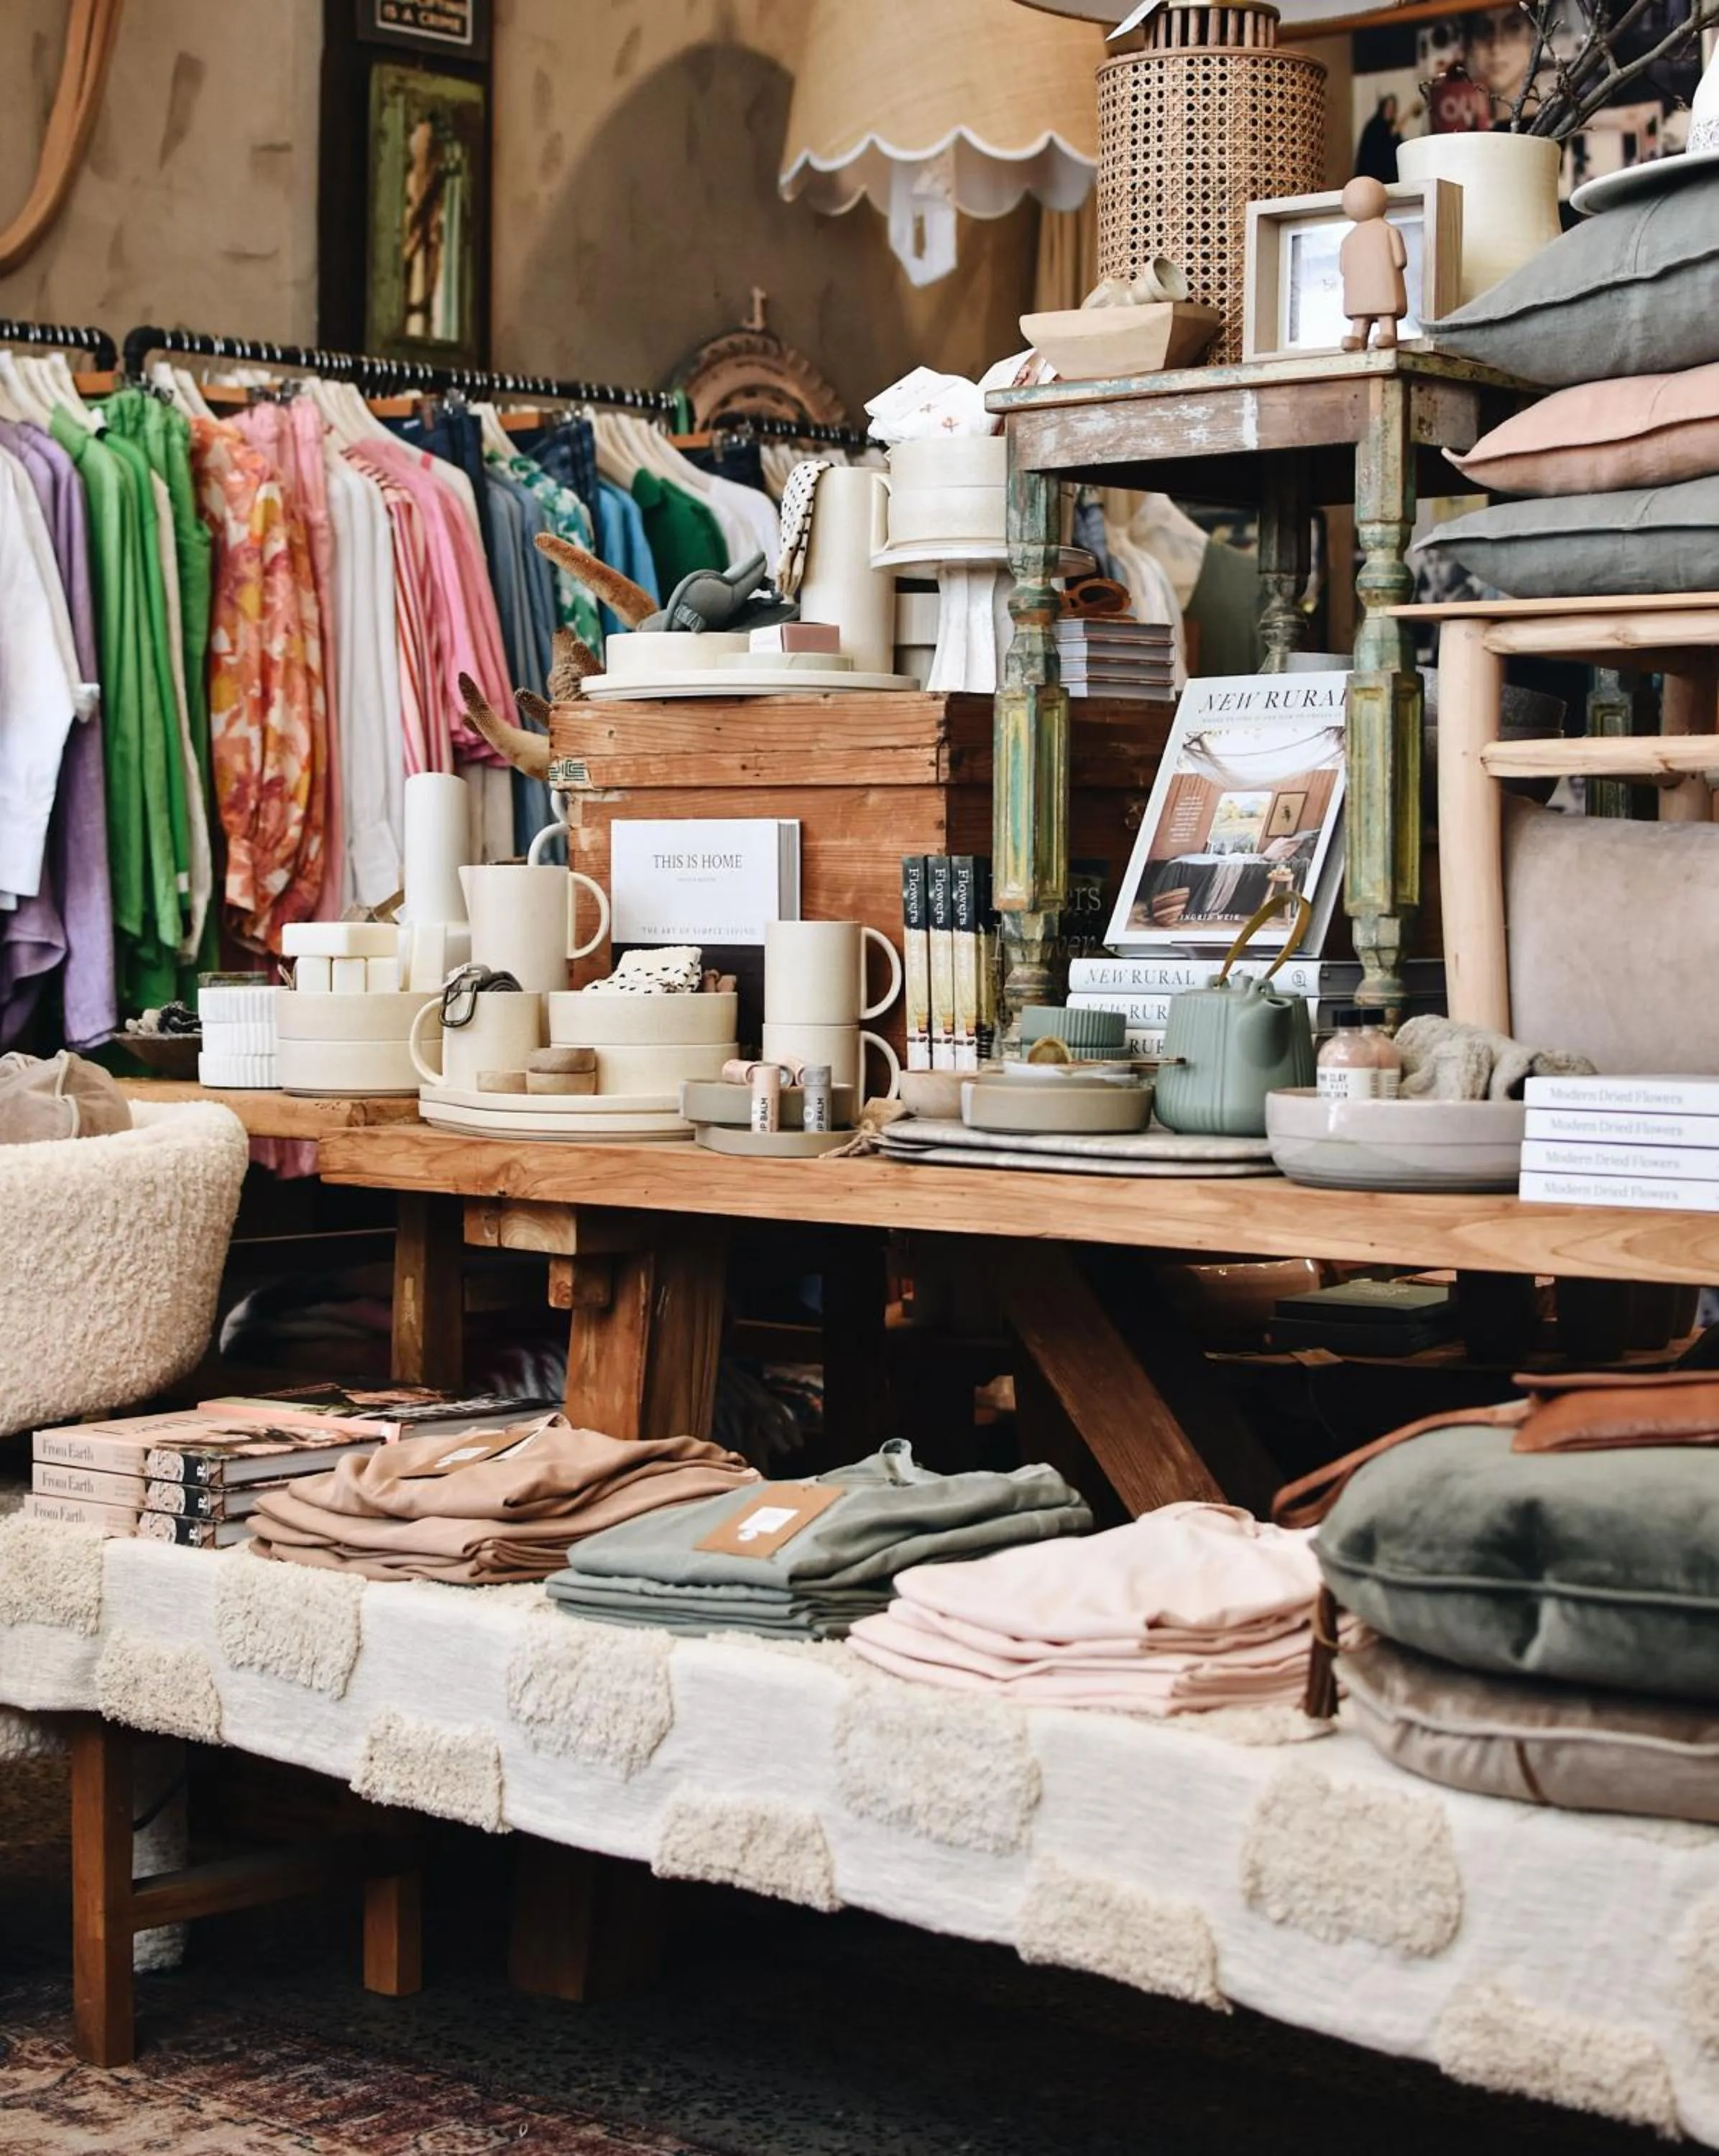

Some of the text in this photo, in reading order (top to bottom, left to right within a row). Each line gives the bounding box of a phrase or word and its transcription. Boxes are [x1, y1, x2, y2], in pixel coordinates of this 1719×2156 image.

[1198, 691, 1261, 714] NEW
[653, 854, 742, 869] THIS IS HOME
[908, 867, 920, 924] Flowers
[935, 867, 946, 925] Flowers
[958, 869, 969, 926] Flowers
[1084, 968, 1195, 985] NEW RURAL
[1549, 1087, 1683, 1105] Modern Dried Flowers
[760, 1097, 769, 1120] BALM
[816, 1097, 825, 1120] BALM
[1550, 1118, 1683, 1136] Modern Dried Flowers
[1545, 1151, 1680, 1169] Modern Dried Flowers
[1544, 1182, 1679, 1200] Modern Dried Flowers
[42, 1439, 68, 1457] From
[68, 1443, 94, 1460] Earth
[42, 1471, 68, 1488] From
[68, 1474, 94, 1493] Earth
[34, 1503, 59, 1520] From
